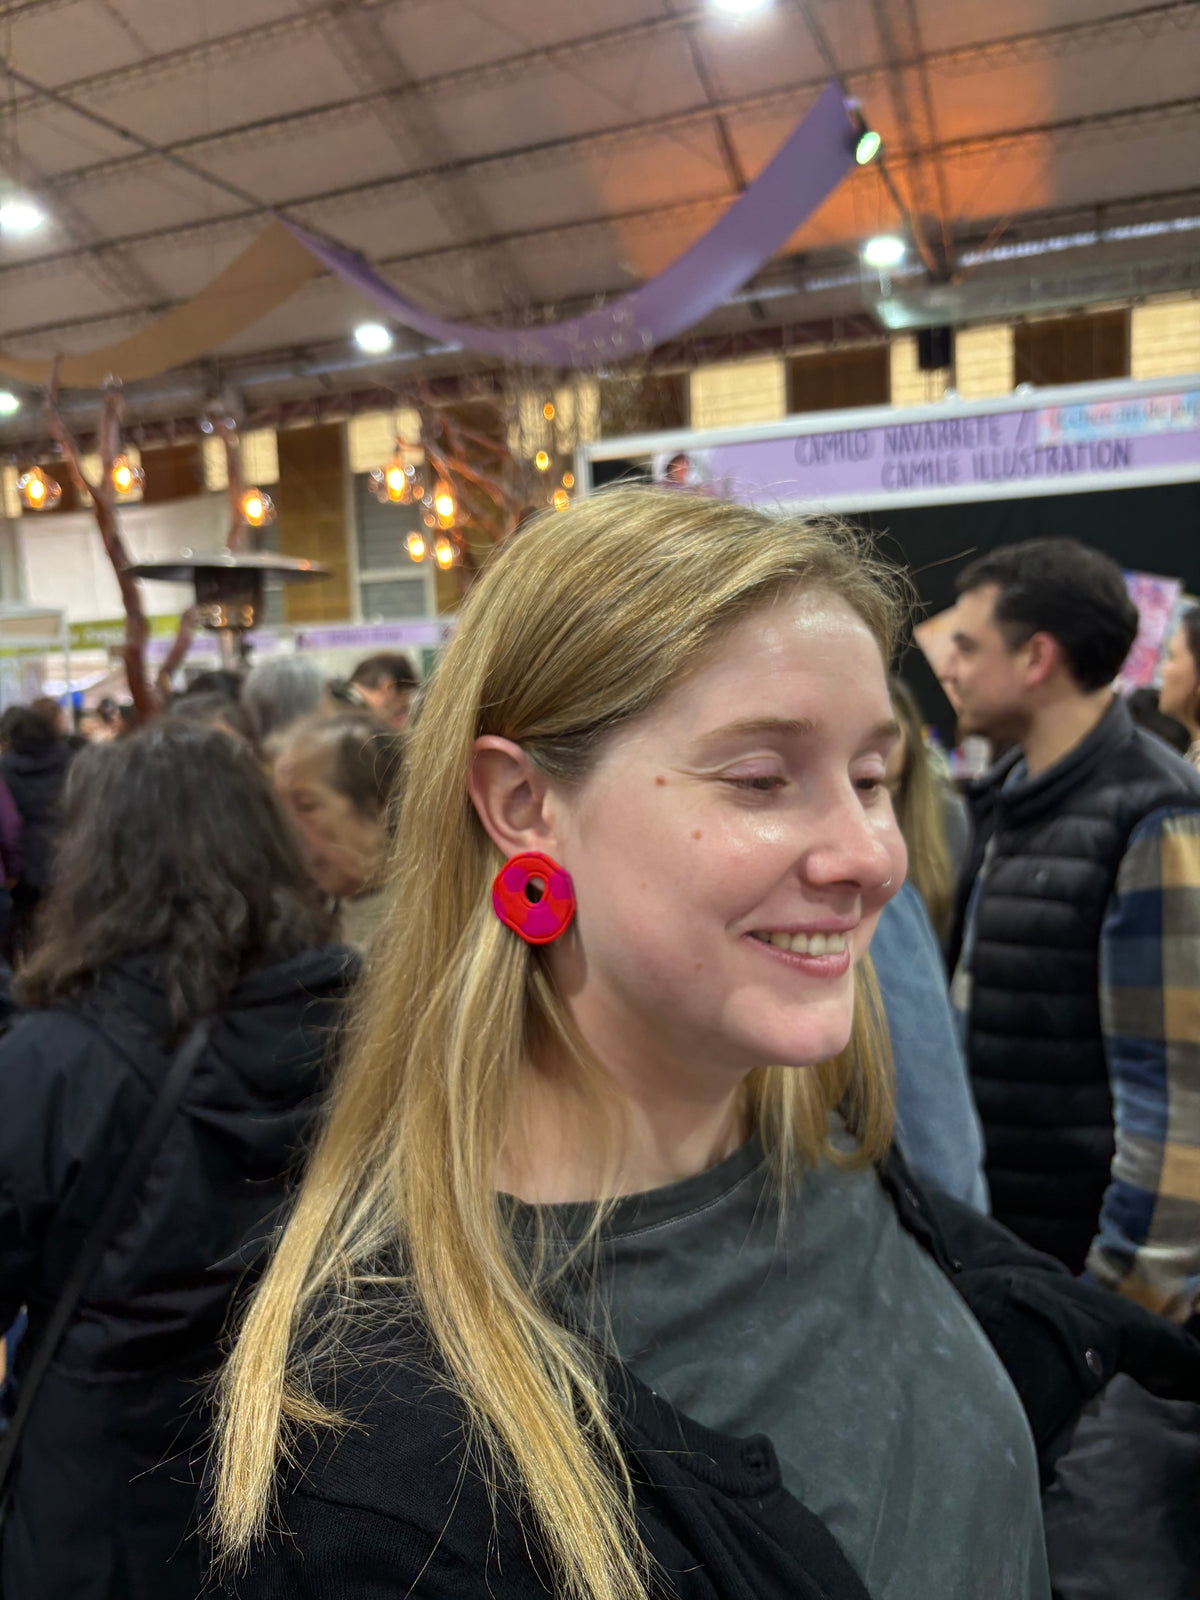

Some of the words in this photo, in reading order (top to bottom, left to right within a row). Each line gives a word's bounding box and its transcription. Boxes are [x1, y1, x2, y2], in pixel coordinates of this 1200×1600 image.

[794, 429, 872, 467] CAMILO
[884, 414, 1005, 457] NAVARRETE
[880, 453, 960, 491] CAMILE
[971, 440, 1132, 481] ILLUSTRATION
